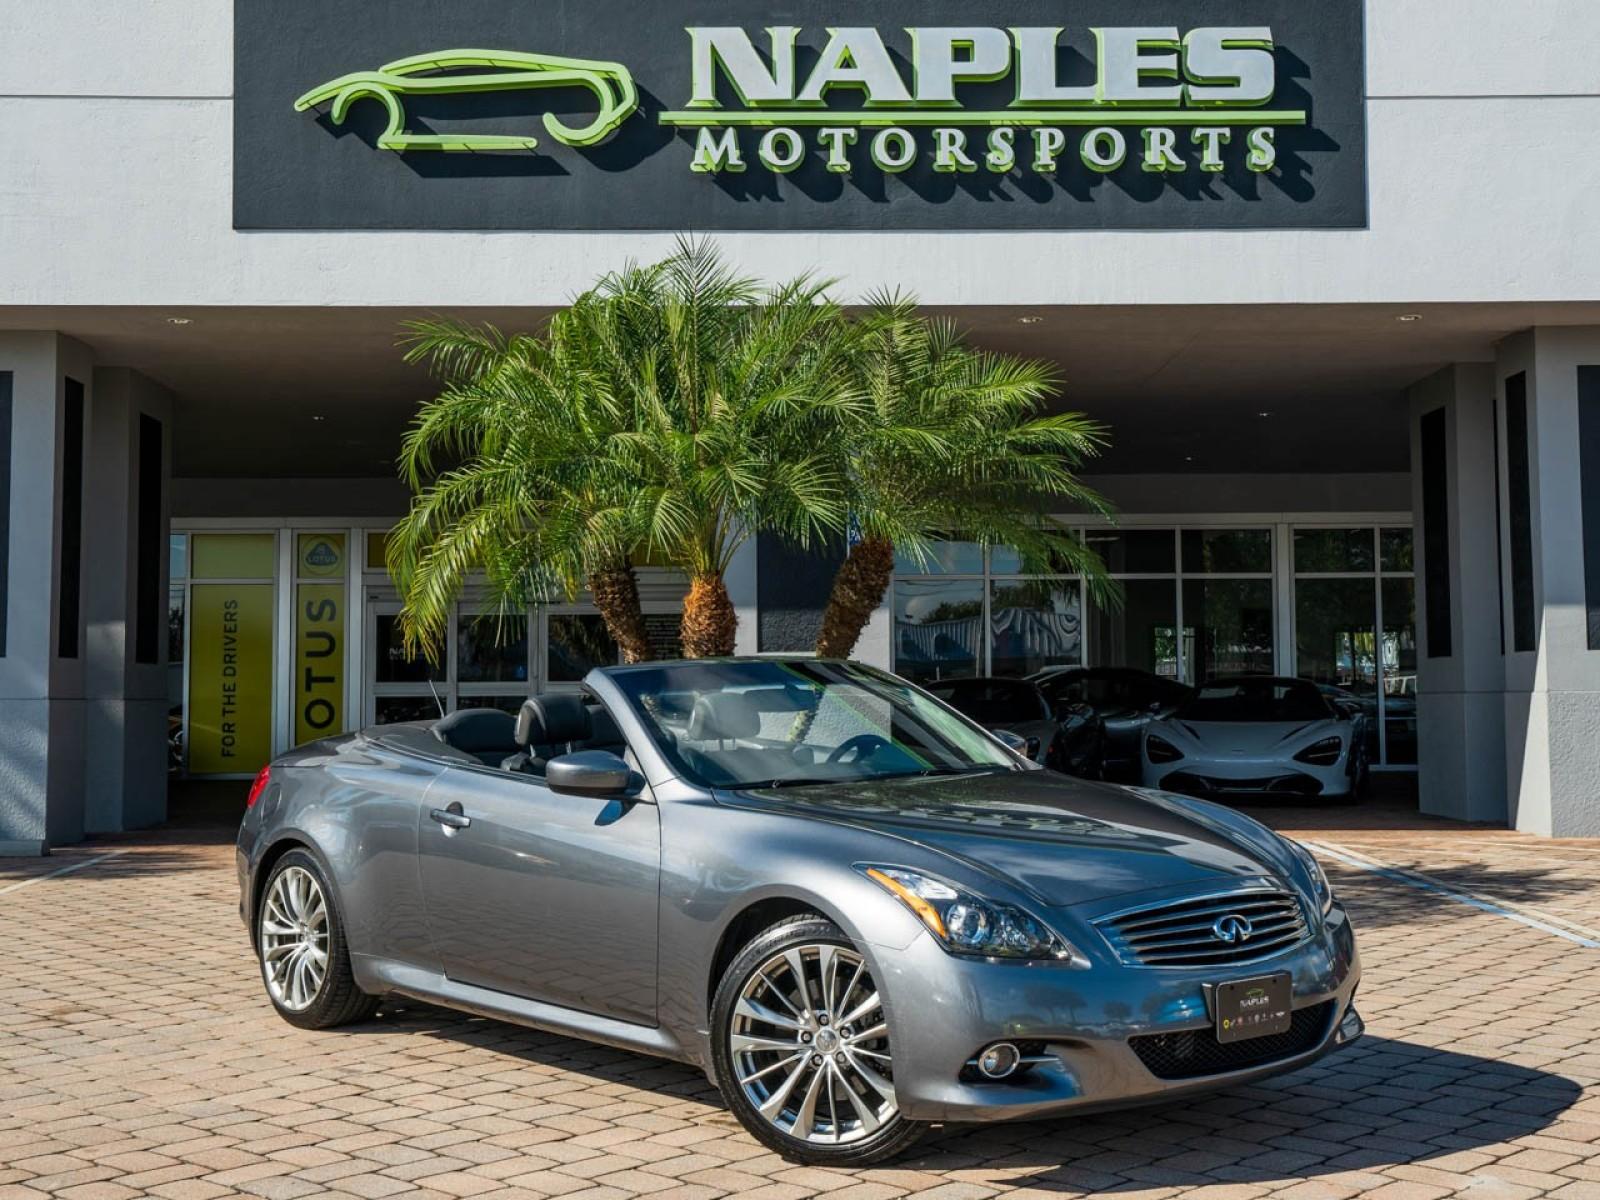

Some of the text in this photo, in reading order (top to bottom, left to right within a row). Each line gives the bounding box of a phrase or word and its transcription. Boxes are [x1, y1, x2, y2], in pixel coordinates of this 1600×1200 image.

[685, 26, 1275, 108] NAPLES
[690, 127, 1276, 173] MOTORSPORTS
[221, 600, 238, 757] FOR THE DRIVERS
[304, 598, 337, 736] OTUS
